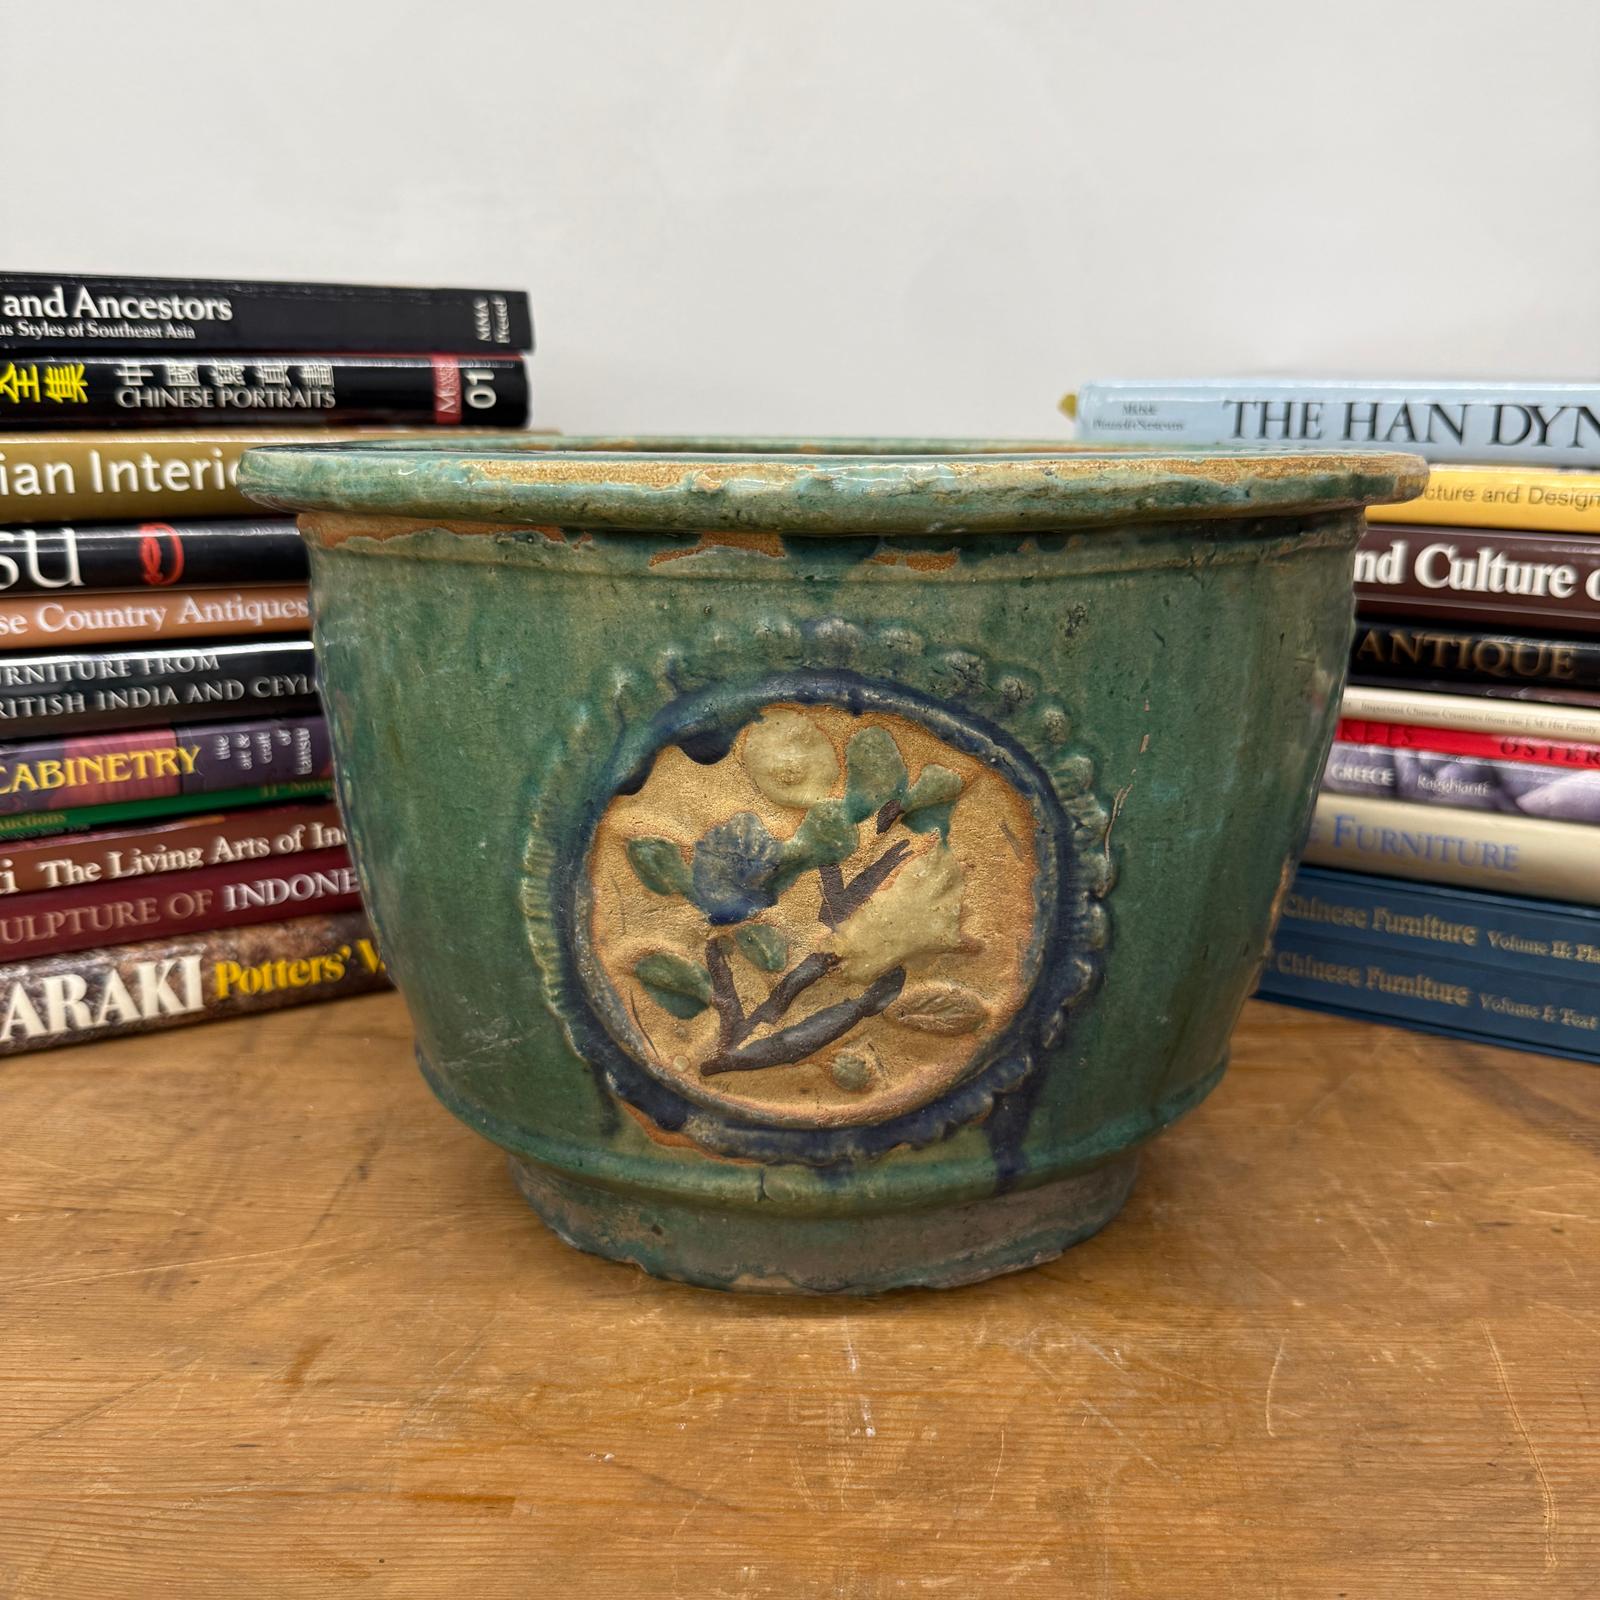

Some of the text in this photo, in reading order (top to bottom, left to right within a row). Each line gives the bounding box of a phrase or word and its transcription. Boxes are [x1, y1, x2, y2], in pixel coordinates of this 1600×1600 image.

[3, 284, 233, 321] and Ancestors
[16, 319, 65, 340] Styles
[67, 320, 84, 338] of
[85, 320, 163, 339] Southeast
[163, 322, 196, 340] Asia
[116, 387, 335, 408] CHINESE PORTRAITS
[464, 367, 496, 409] 01
[1223, 399, 1323, 440] THE
[1339, 399, 1472, 445] HAN
[0, 454, 75, 496] ian
[1481, 485, 1520, 505] and
[1414, 542, 1579, 599] Culture
[35, 602, 167, 632] Country
[177, 593, 309, 627] Antiques
[0, 655, 221, 687] RNITURE FROM
[1356, 628, 1578, 680] ANTIQUE
[93, 684, 181, 711] INDIA
[184, 678, 245, 704] AND
[250, 672, 317, 699] CEYL
[34, 857, 102, 889] The
[105, 844, 205, 880] Living
[209, 836, 271, 865] Arts
[273, 824, 306, 855] of
[308, 822, 347, 850] In
[1, 896, 161, 945] ULPTURE
[166, 889, 214, 921] OF
[1282, 896, 1368, 929] Chinese
[1372, 907, 1479, 947] Furniture
[1487, 930, 1550, 957] Volume
[0, 954, 206, 1043] ARAKI
[1277, 952, 1362, 988] Chinese
[1365, 965, 1472, 1008] Furniture
[1479, 992, 1541, 1020] Volume
